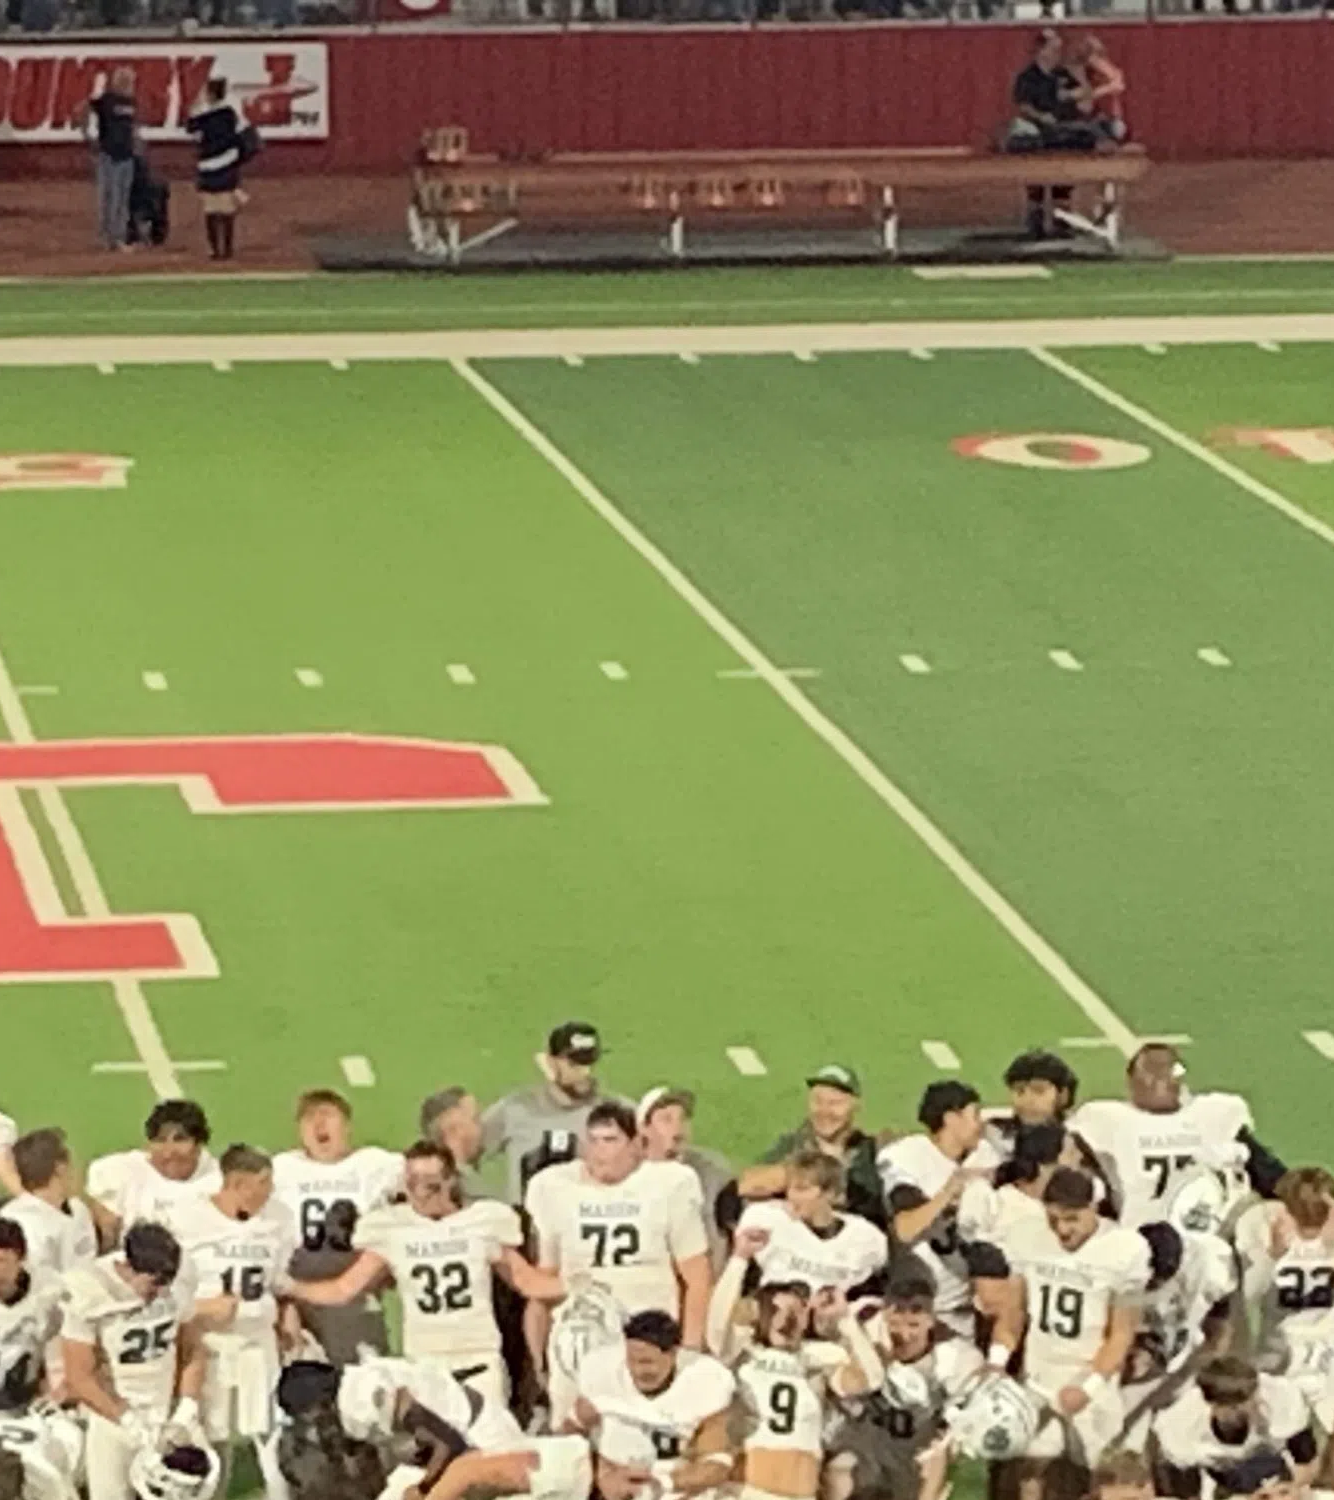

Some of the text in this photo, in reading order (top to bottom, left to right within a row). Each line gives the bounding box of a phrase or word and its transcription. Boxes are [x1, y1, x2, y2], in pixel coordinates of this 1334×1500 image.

[1142, 1154, 1197, 1200] 7
[580, 1223, 640, 1268] 72
[412, 1261, 473, 1315] 32
[1039, 1284, 1084, 1340] 19
[119, 1318, 176, 1364] 25
[768, 1382, 798, 1435] 9
